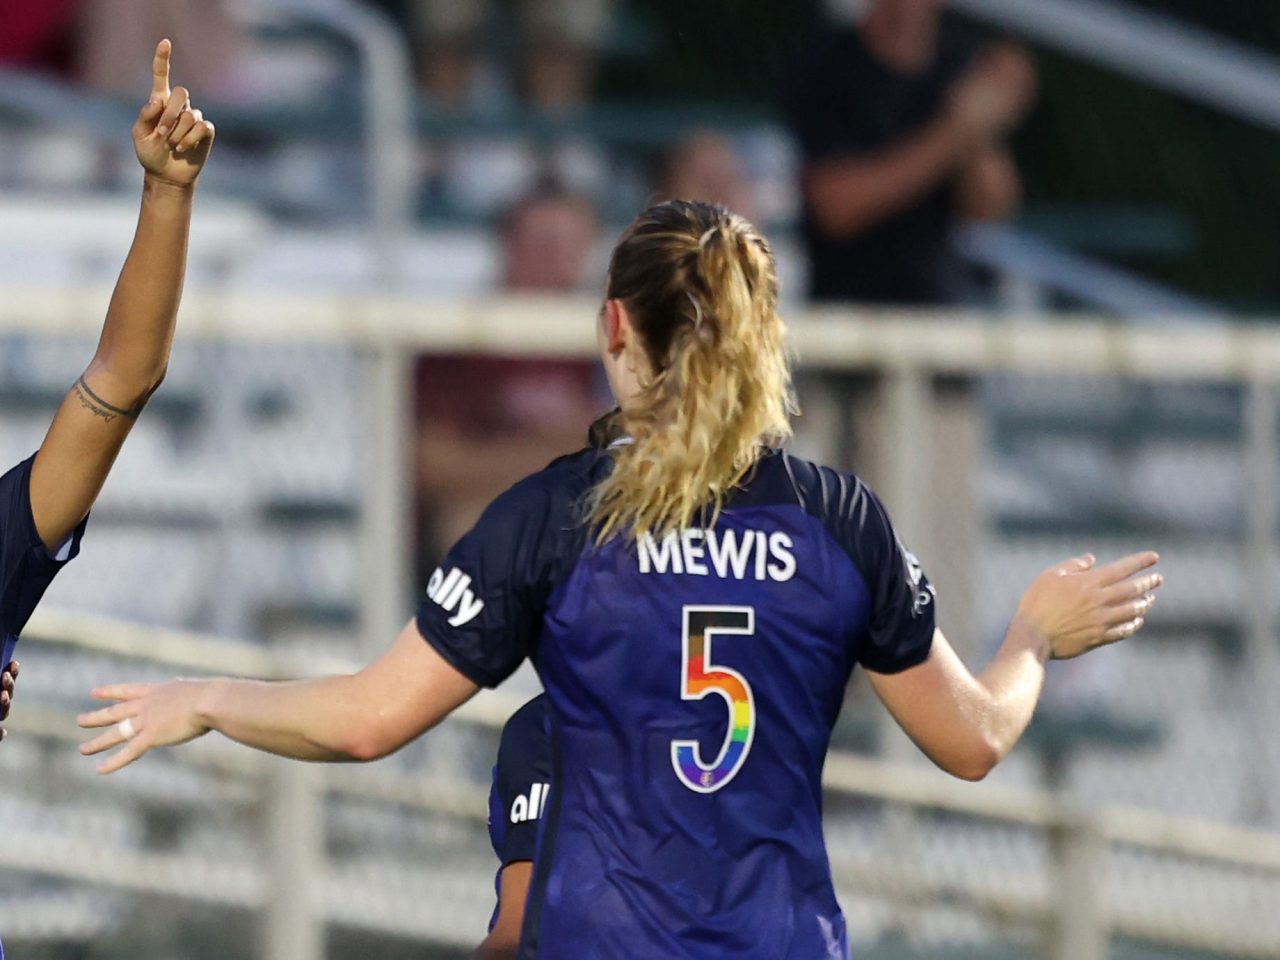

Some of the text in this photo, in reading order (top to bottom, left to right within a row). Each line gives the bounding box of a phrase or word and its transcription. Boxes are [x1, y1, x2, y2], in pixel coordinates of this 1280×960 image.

[636, 528, 796, 581] MEWIS
[426, 566, 484, 627] ally
[671, 605, 755, 793] 5
[510, 782, 551, 824] all
